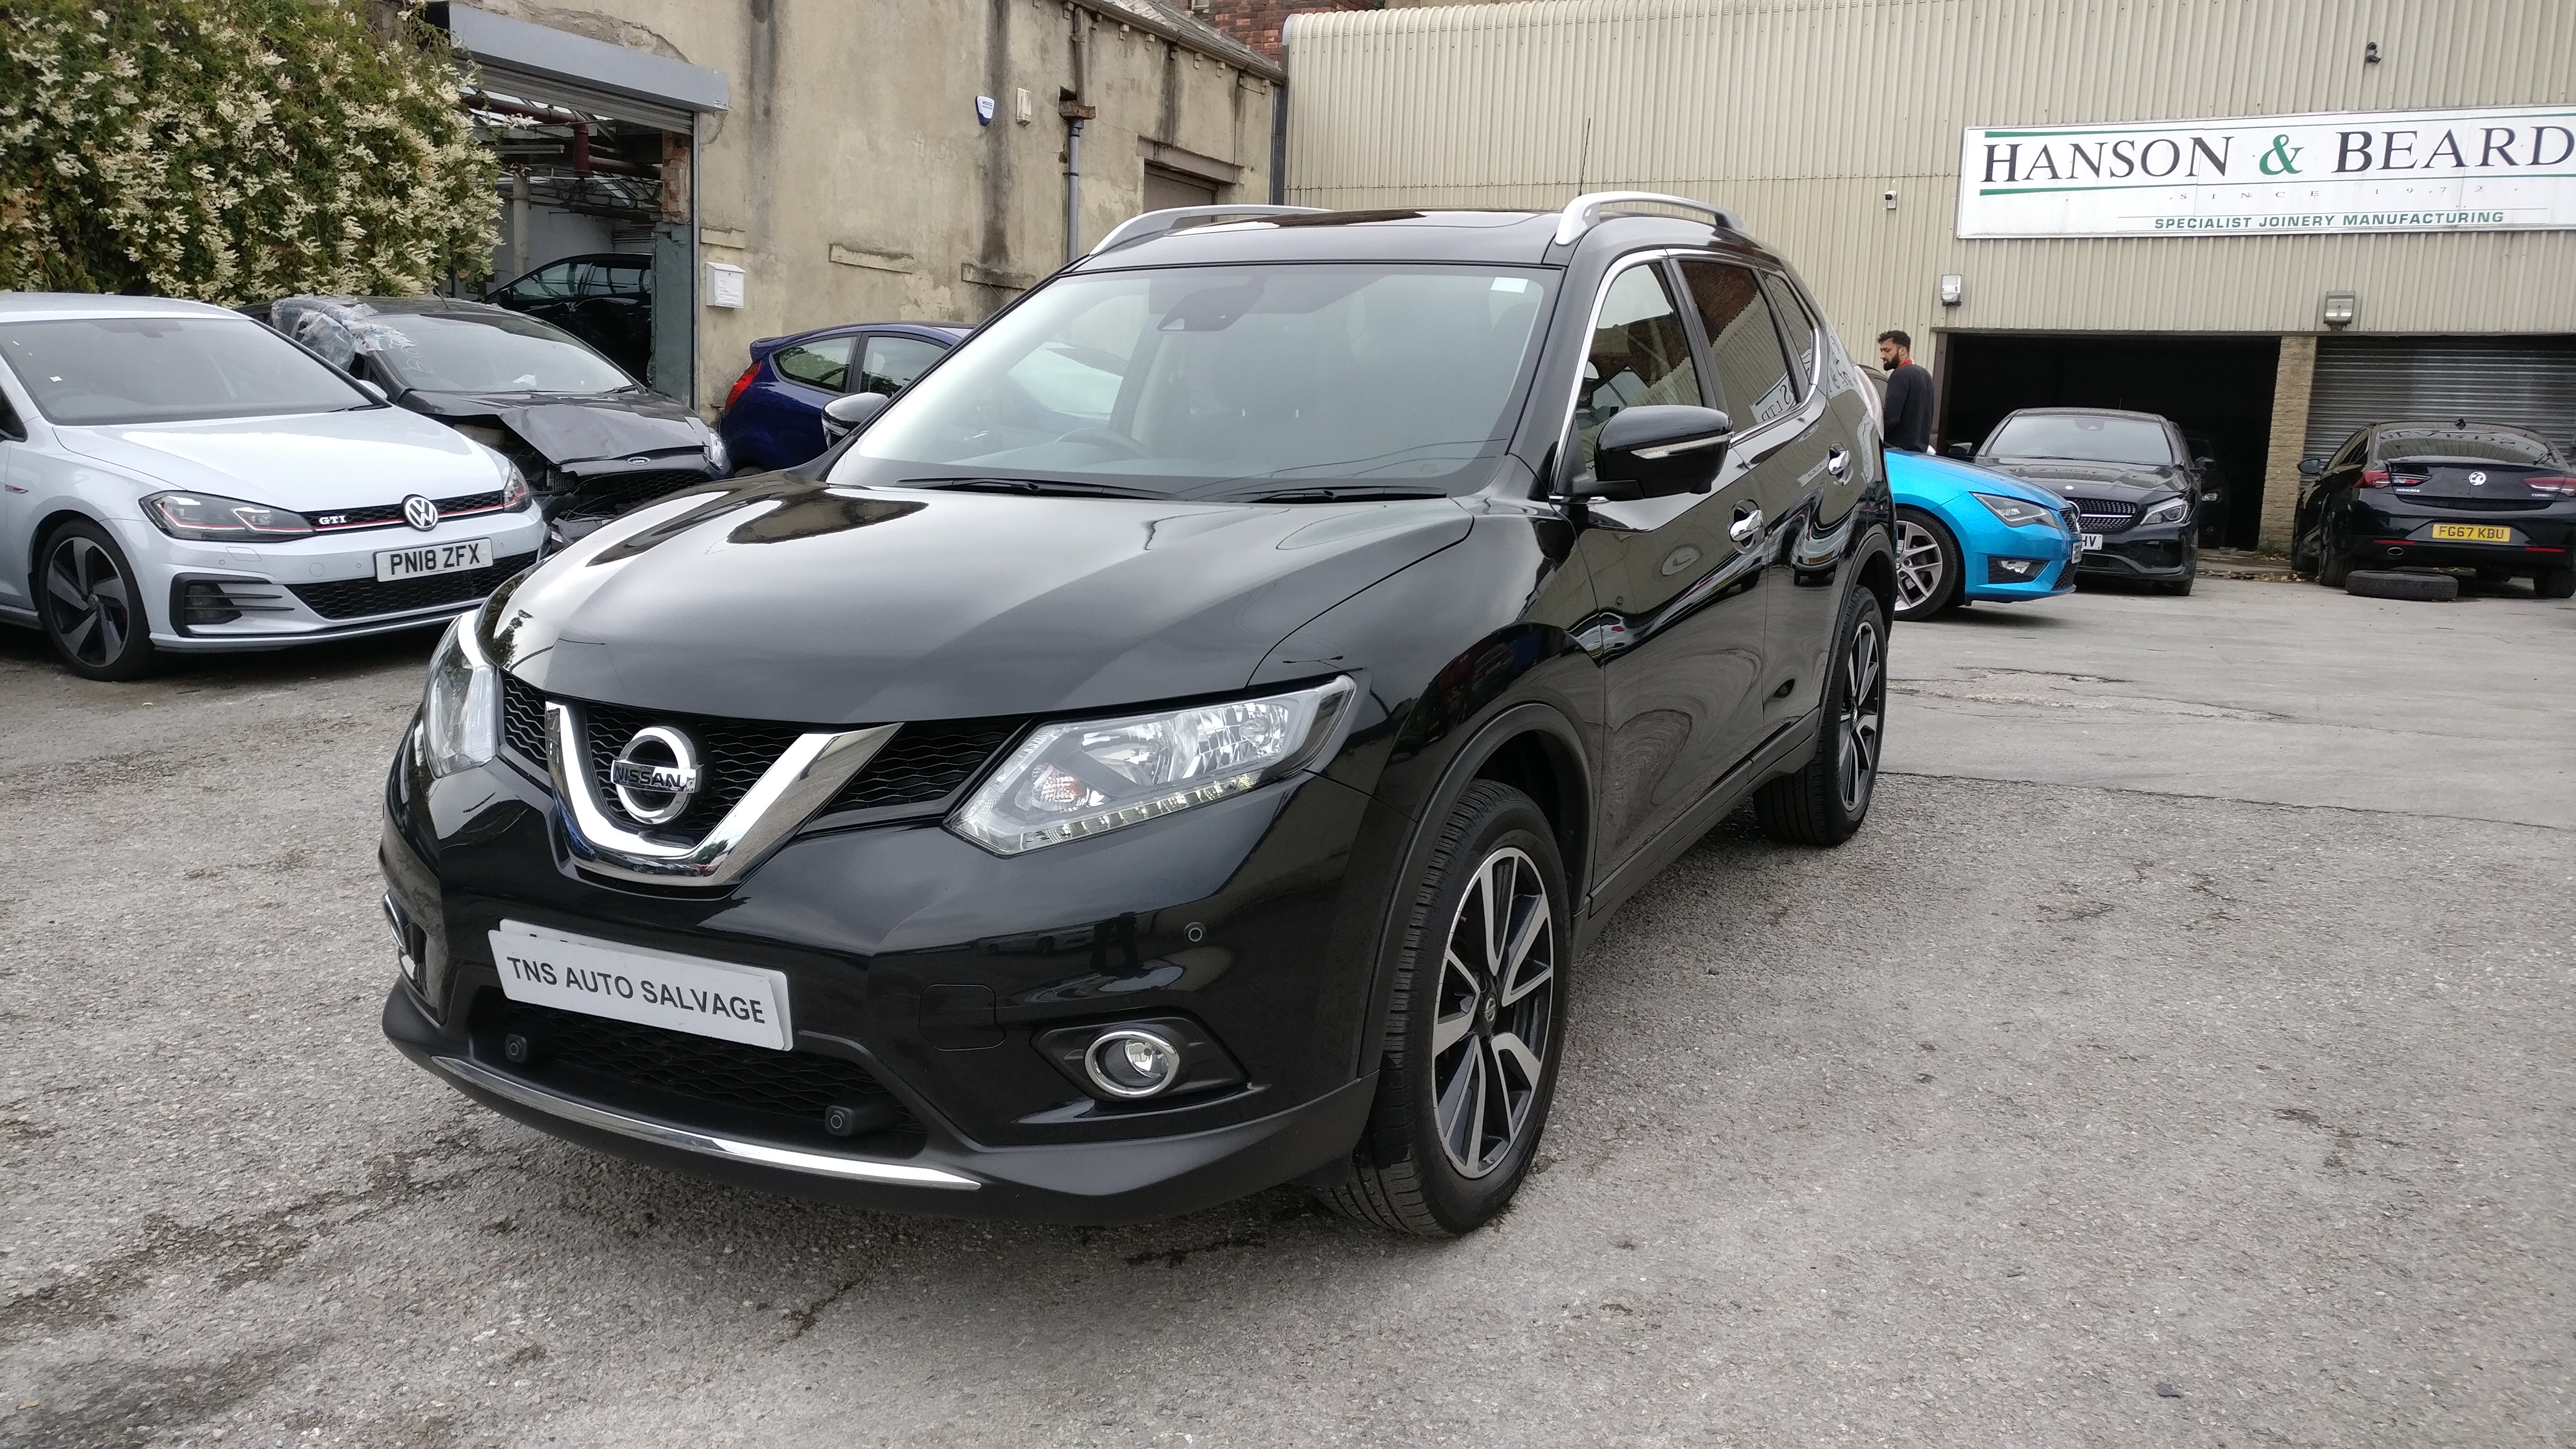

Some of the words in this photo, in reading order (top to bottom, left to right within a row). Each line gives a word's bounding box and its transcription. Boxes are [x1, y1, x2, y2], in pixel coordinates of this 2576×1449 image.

[1980, 136, 2235, 183] HANSON
[2258, 133, 2305, 175] &
[2330, 125, 2575, 174] BEARD
[2179, 190, 2320, 200] SINCE
[2374, 185, 2483, 195] 1972
[2154, 217, 2252, 229] SPECIALIST
[2258, 215, 2336, 228] JOINERY
[2342, 212, 2504, 226] MANUFACTURING
[319, 515, 347, 525] GTI
[2438, 525, 2474, 537] FG67
[2478, 527, 2505, 539] KBU
[390, 549, 437, 575] PN18
[442, 543, 480, 568] ZFX
[613, 764, 681, 788] NISSAN
[506, 955, 557, 986] TNS
[565, 967, 634, 999] AUTO
[640, 980, 766, 1024] SALVAGE
